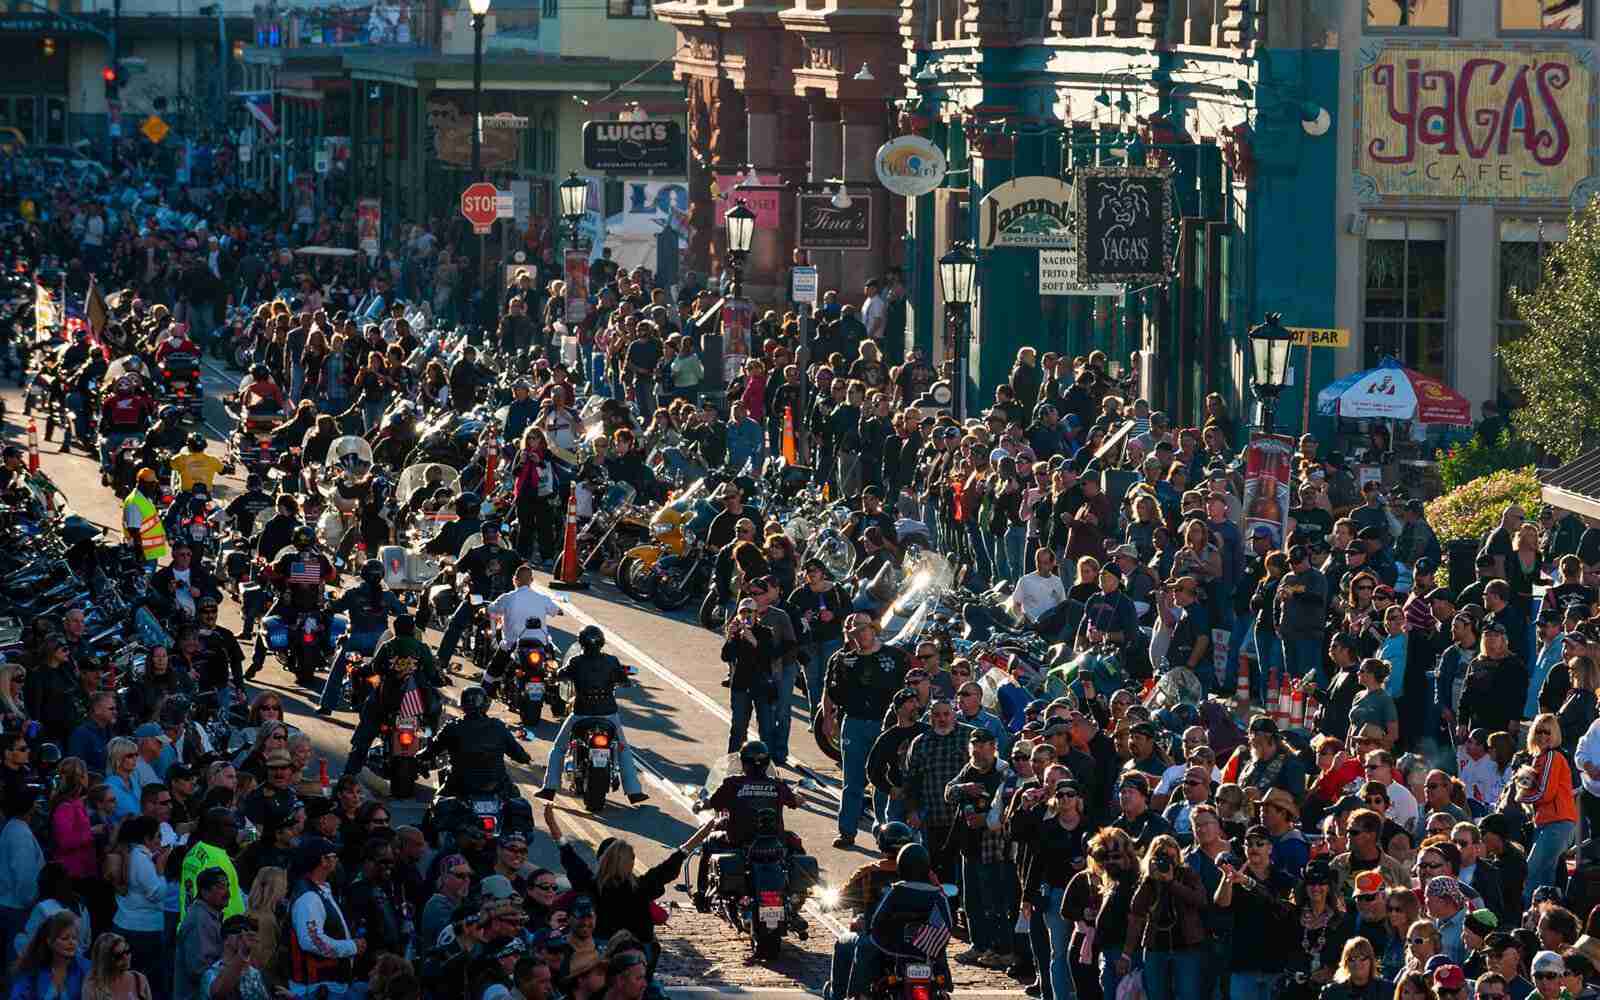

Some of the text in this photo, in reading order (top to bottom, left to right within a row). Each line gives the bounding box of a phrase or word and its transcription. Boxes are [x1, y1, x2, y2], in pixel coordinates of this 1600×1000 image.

[596, 122, 667, 141] LUIGI'S
[1425, 162, 1513, 181] CAFE
[464, 195, 497, 213] STOP
[804, 206, 865, 230] Tina's
[1100, 237, 1149, 260] YAGA'S
[1042, 256, 1078, 265] NACHOS
[1042, 269, 1068, 278] FRITO
[1042, 282, 1099, 291] SOFT DRKS
[1312, 331, 1338, 343] BAR
